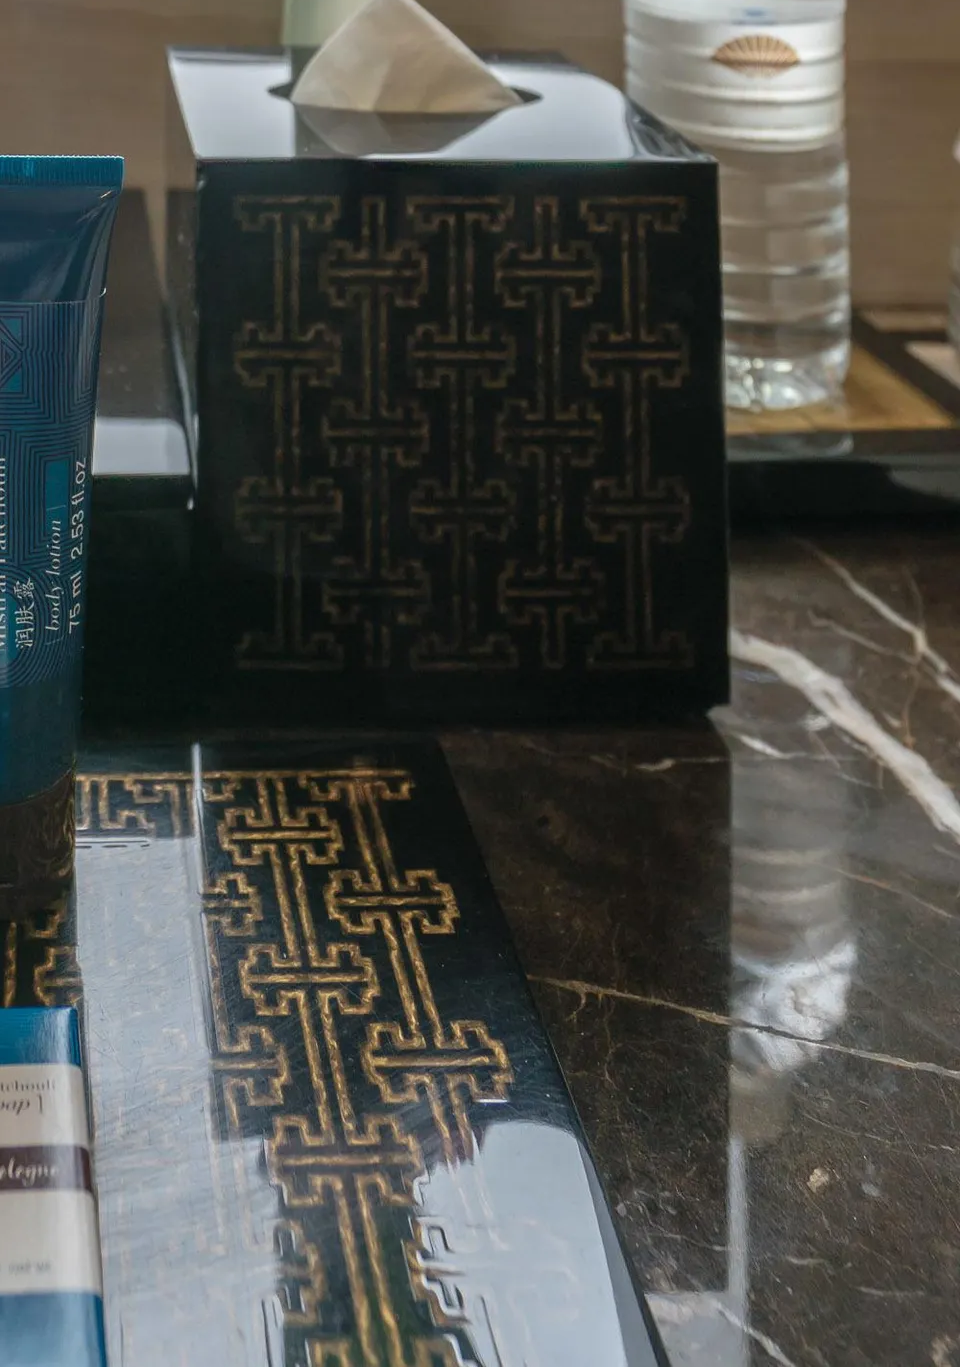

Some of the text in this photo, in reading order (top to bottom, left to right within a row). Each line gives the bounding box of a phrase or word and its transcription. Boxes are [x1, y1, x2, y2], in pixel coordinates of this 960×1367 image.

[45, 520, 65, 632] body lotion
[69, 456, 87, 634] 75 ml 2.53 fl.oz
[13, 577, 35, 650] 润肤露
